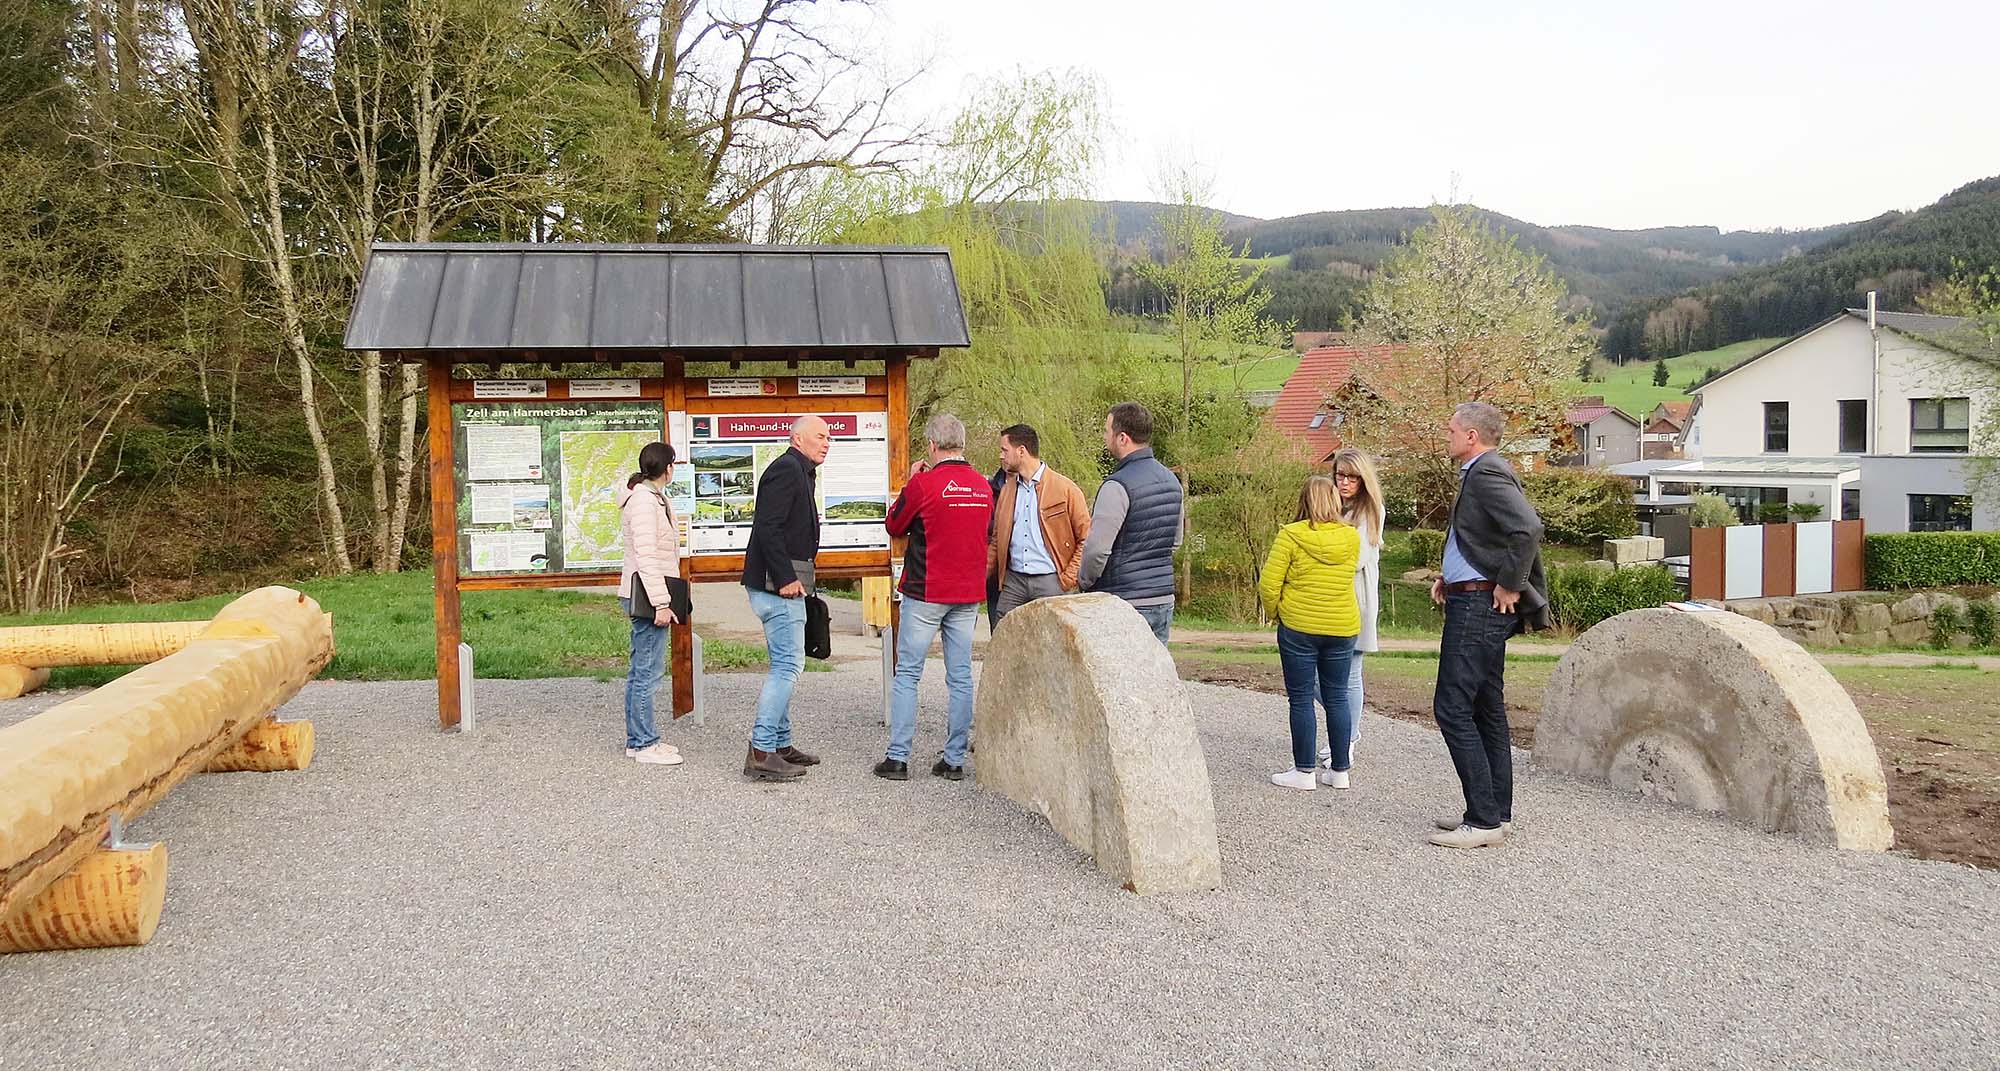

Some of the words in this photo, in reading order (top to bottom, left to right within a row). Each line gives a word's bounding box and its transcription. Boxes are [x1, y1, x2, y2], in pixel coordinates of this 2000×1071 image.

[466, 408, 488, 417] Zell
[491, 409, 510, 417] am
[513, 407, 588, 417] Harmersbach
